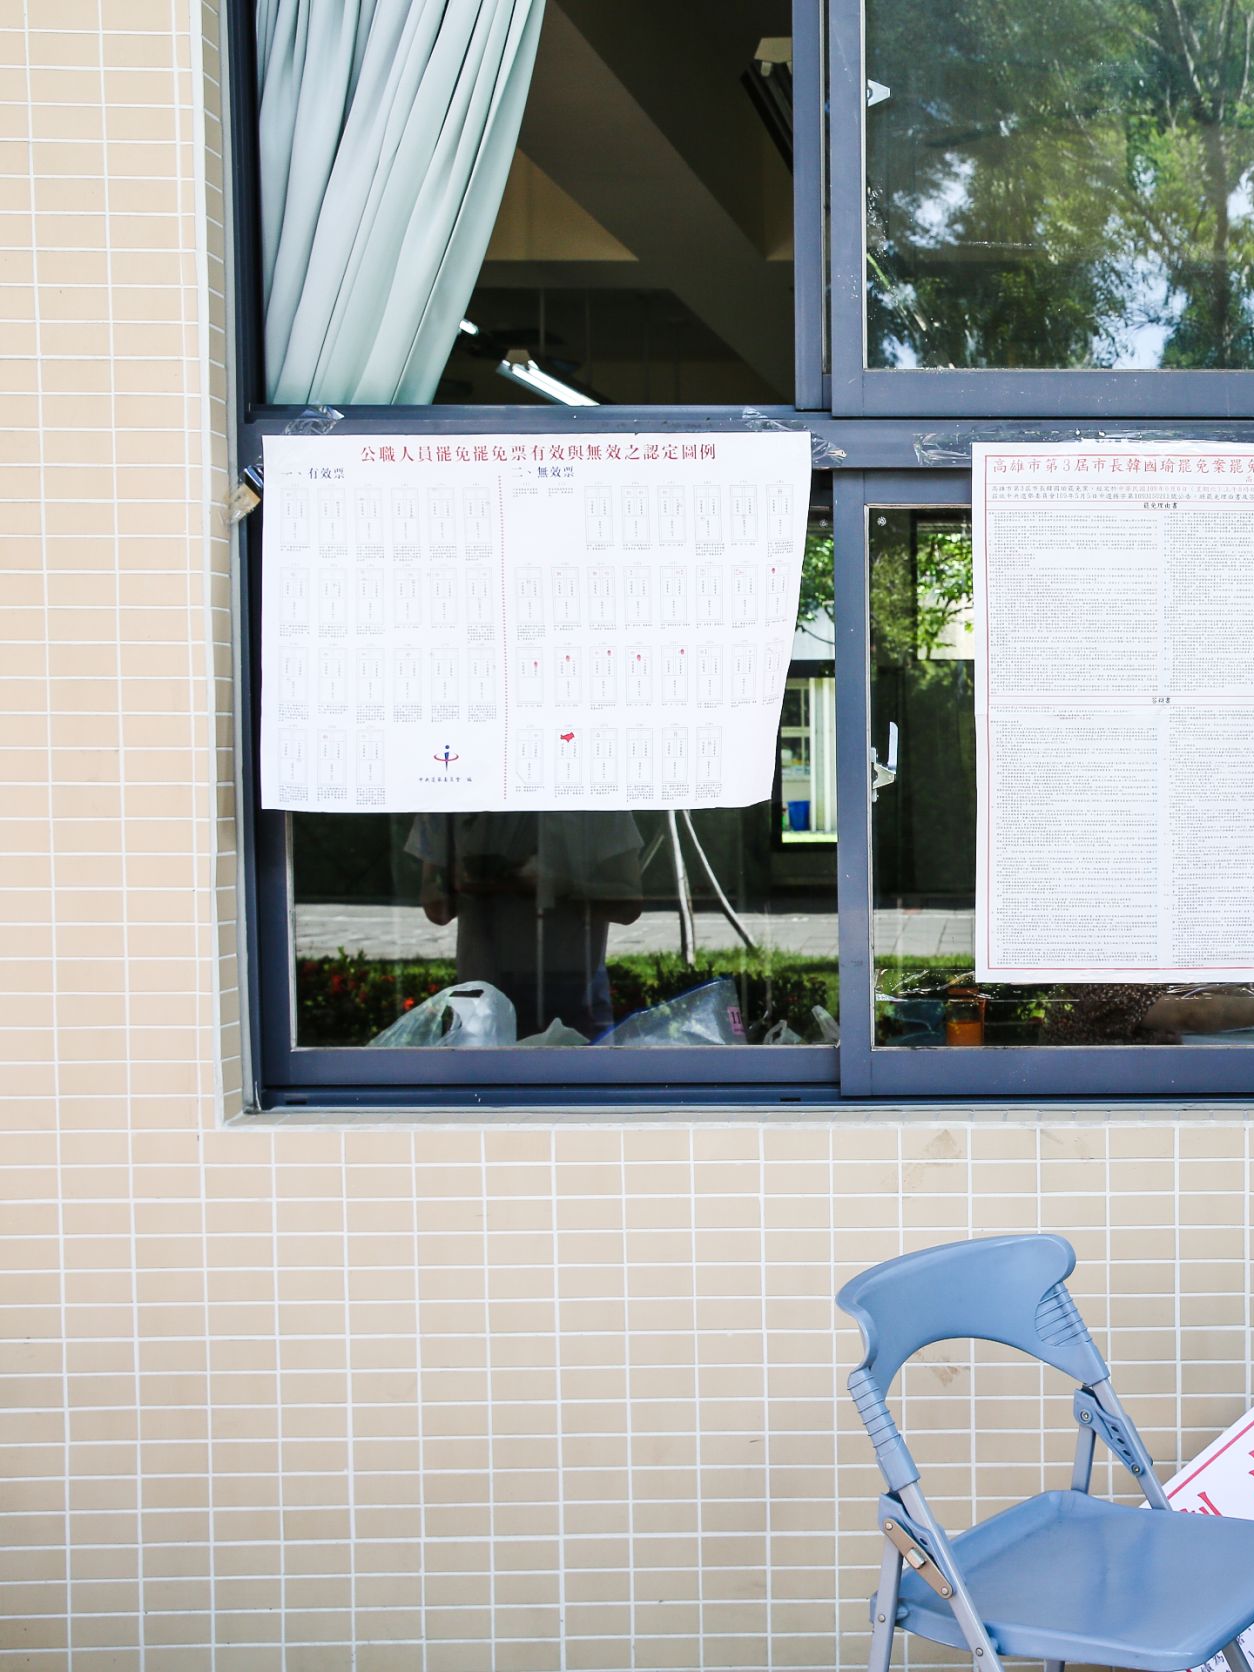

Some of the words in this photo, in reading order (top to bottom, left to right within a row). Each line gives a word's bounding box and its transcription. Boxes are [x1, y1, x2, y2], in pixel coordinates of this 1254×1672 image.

[361, 443, 717, 462] 公職人員罷免罷免票有效與無效之認定圖例
[512, 465, 575, 478] 二、無效票
